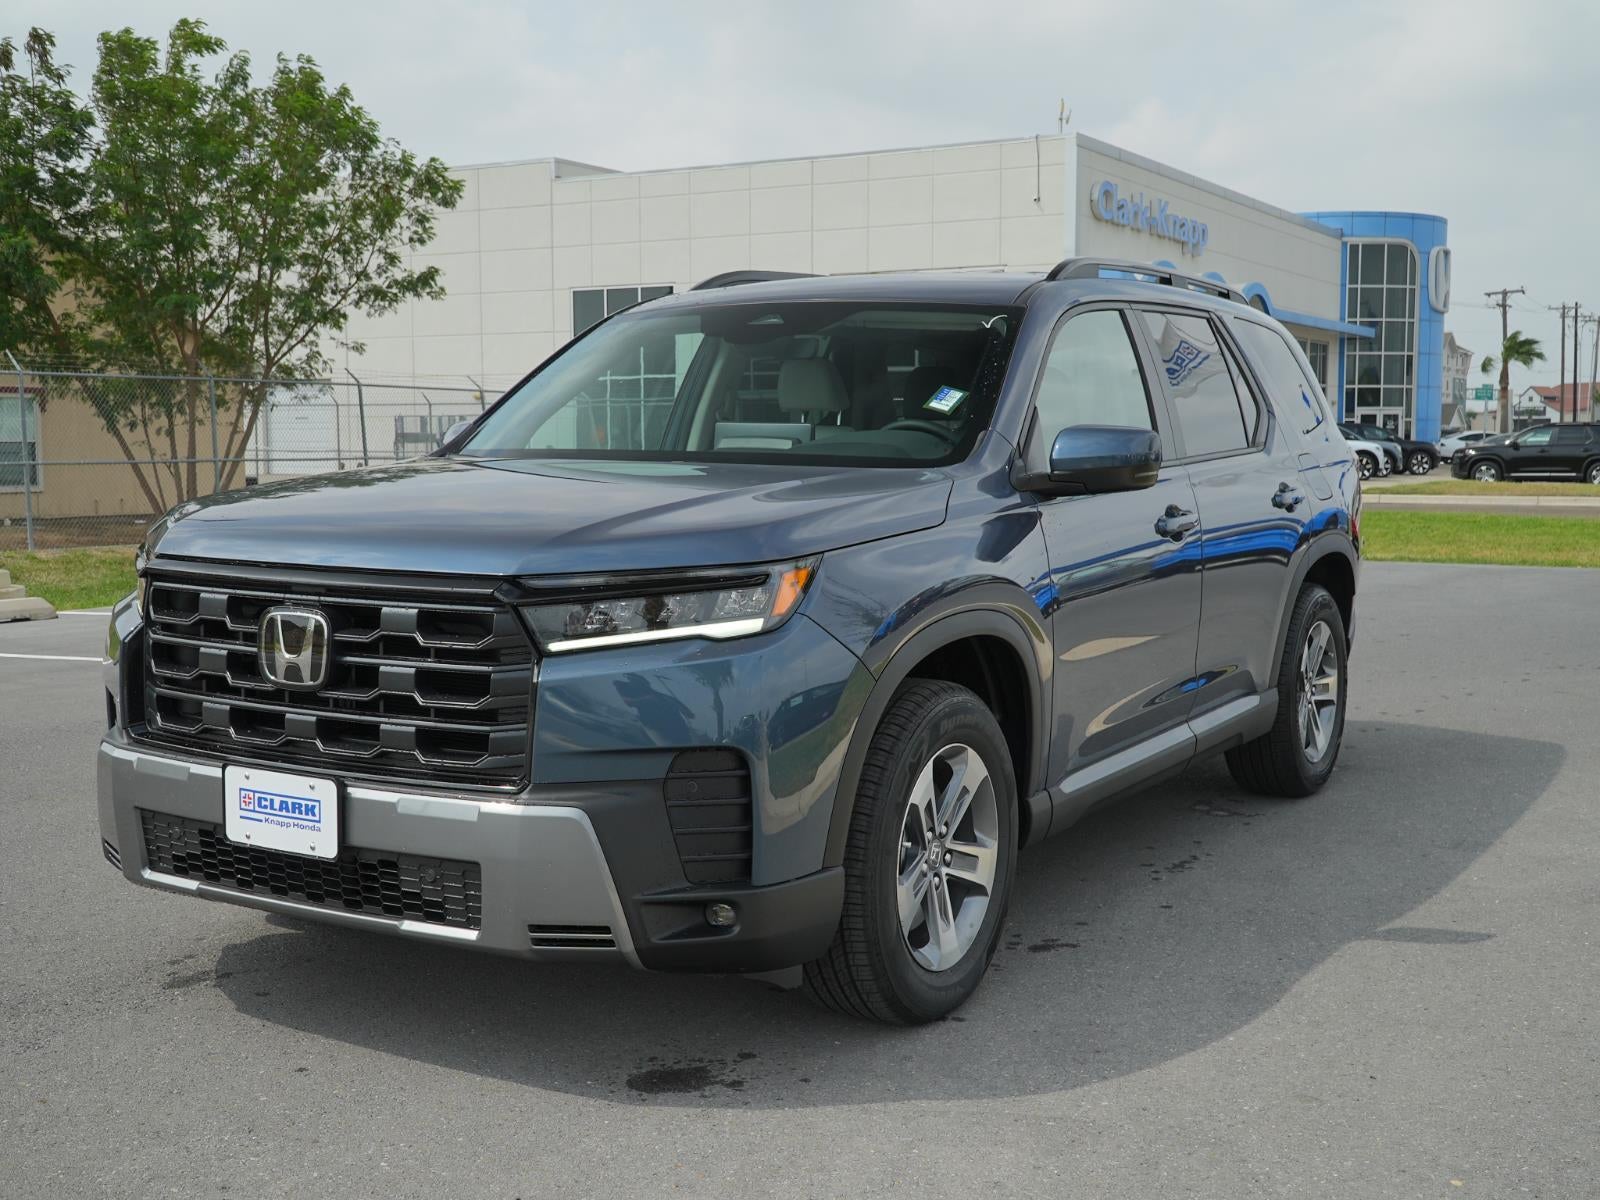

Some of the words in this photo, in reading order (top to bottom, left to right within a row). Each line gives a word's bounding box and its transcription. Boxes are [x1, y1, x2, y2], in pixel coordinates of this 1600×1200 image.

[257, 796, 317, 817] CLARK
[264, 816, 292, 828] Knapp
[293, 822, 321, 832] Honda
